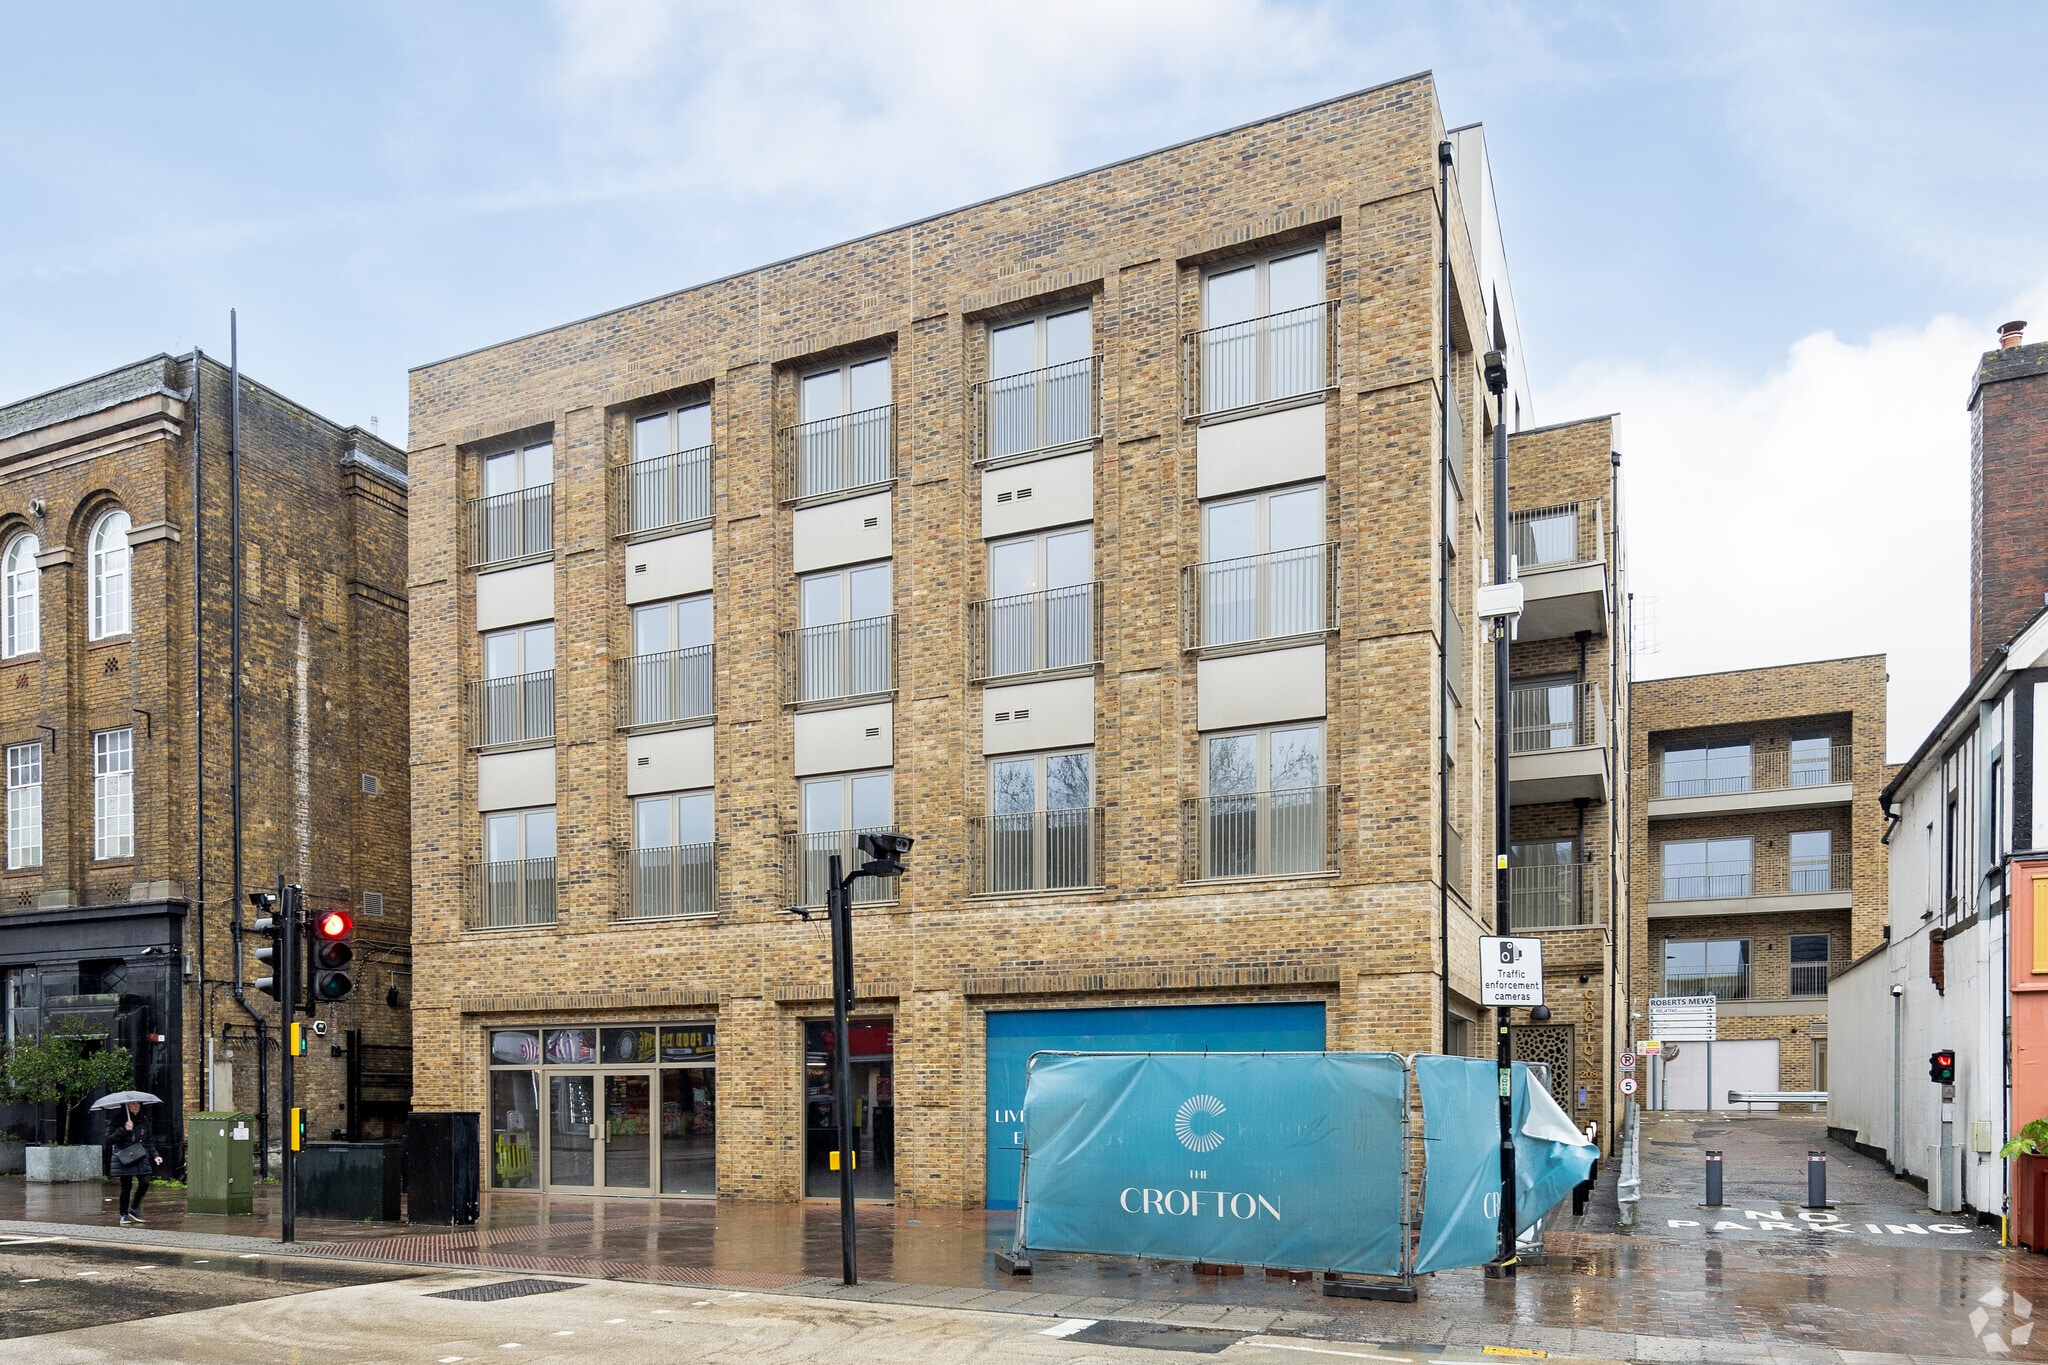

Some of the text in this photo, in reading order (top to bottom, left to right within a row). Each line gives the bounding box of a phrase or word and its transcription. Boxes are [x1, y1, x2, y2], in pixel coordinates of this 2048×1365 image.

[1498, 969, 1525, 978] Traffic
[1485, 980, 1539, 990] enforcement
[1494, 993, 1531, 1001] cameras
[1688, 997, 1714, 1005] MEWS
[1584, 989, 1595, 1067] CROFTON
[1625, 1082, 1632, 1091] 5
[1188, 1169, 1209, 1180] THE
[1120, 1187, 1281, 1222] CROFTON
[1744, 1210, 1839, 1223] NO
[1667, 1219, 1973, 1235] PARKING
